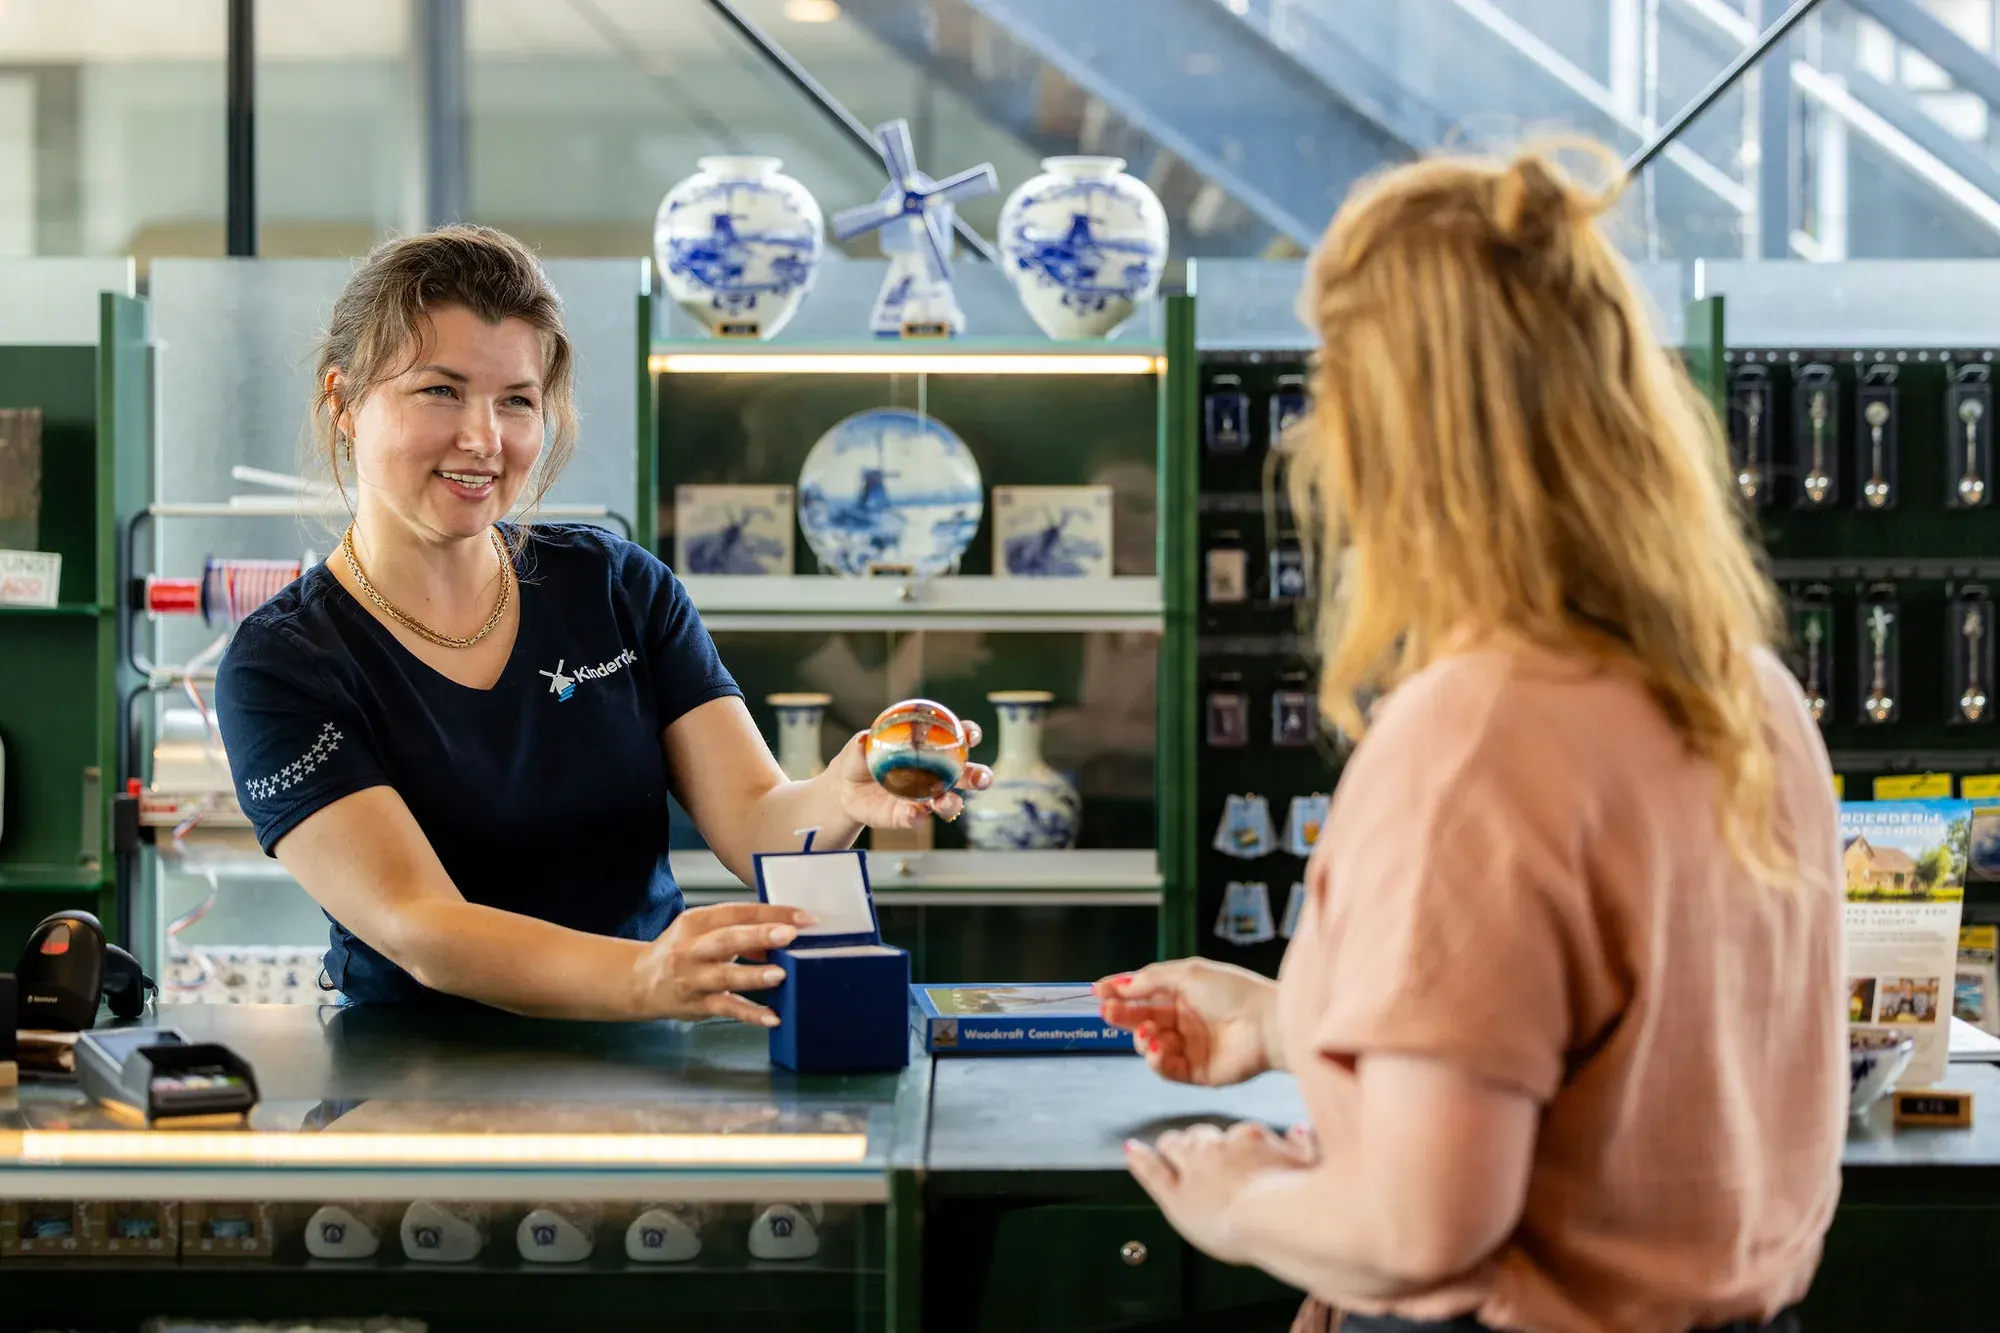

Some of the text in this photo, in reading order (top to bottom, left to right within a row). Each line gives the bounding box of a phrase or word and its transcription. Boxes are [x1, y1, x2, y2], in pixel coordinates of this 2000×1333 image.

[964, 1028, 1024, 1040] Woodcraft
[1028, 1028, 1098, 1040] Construction
[1102, 1028, 1118, 1039] Kit
